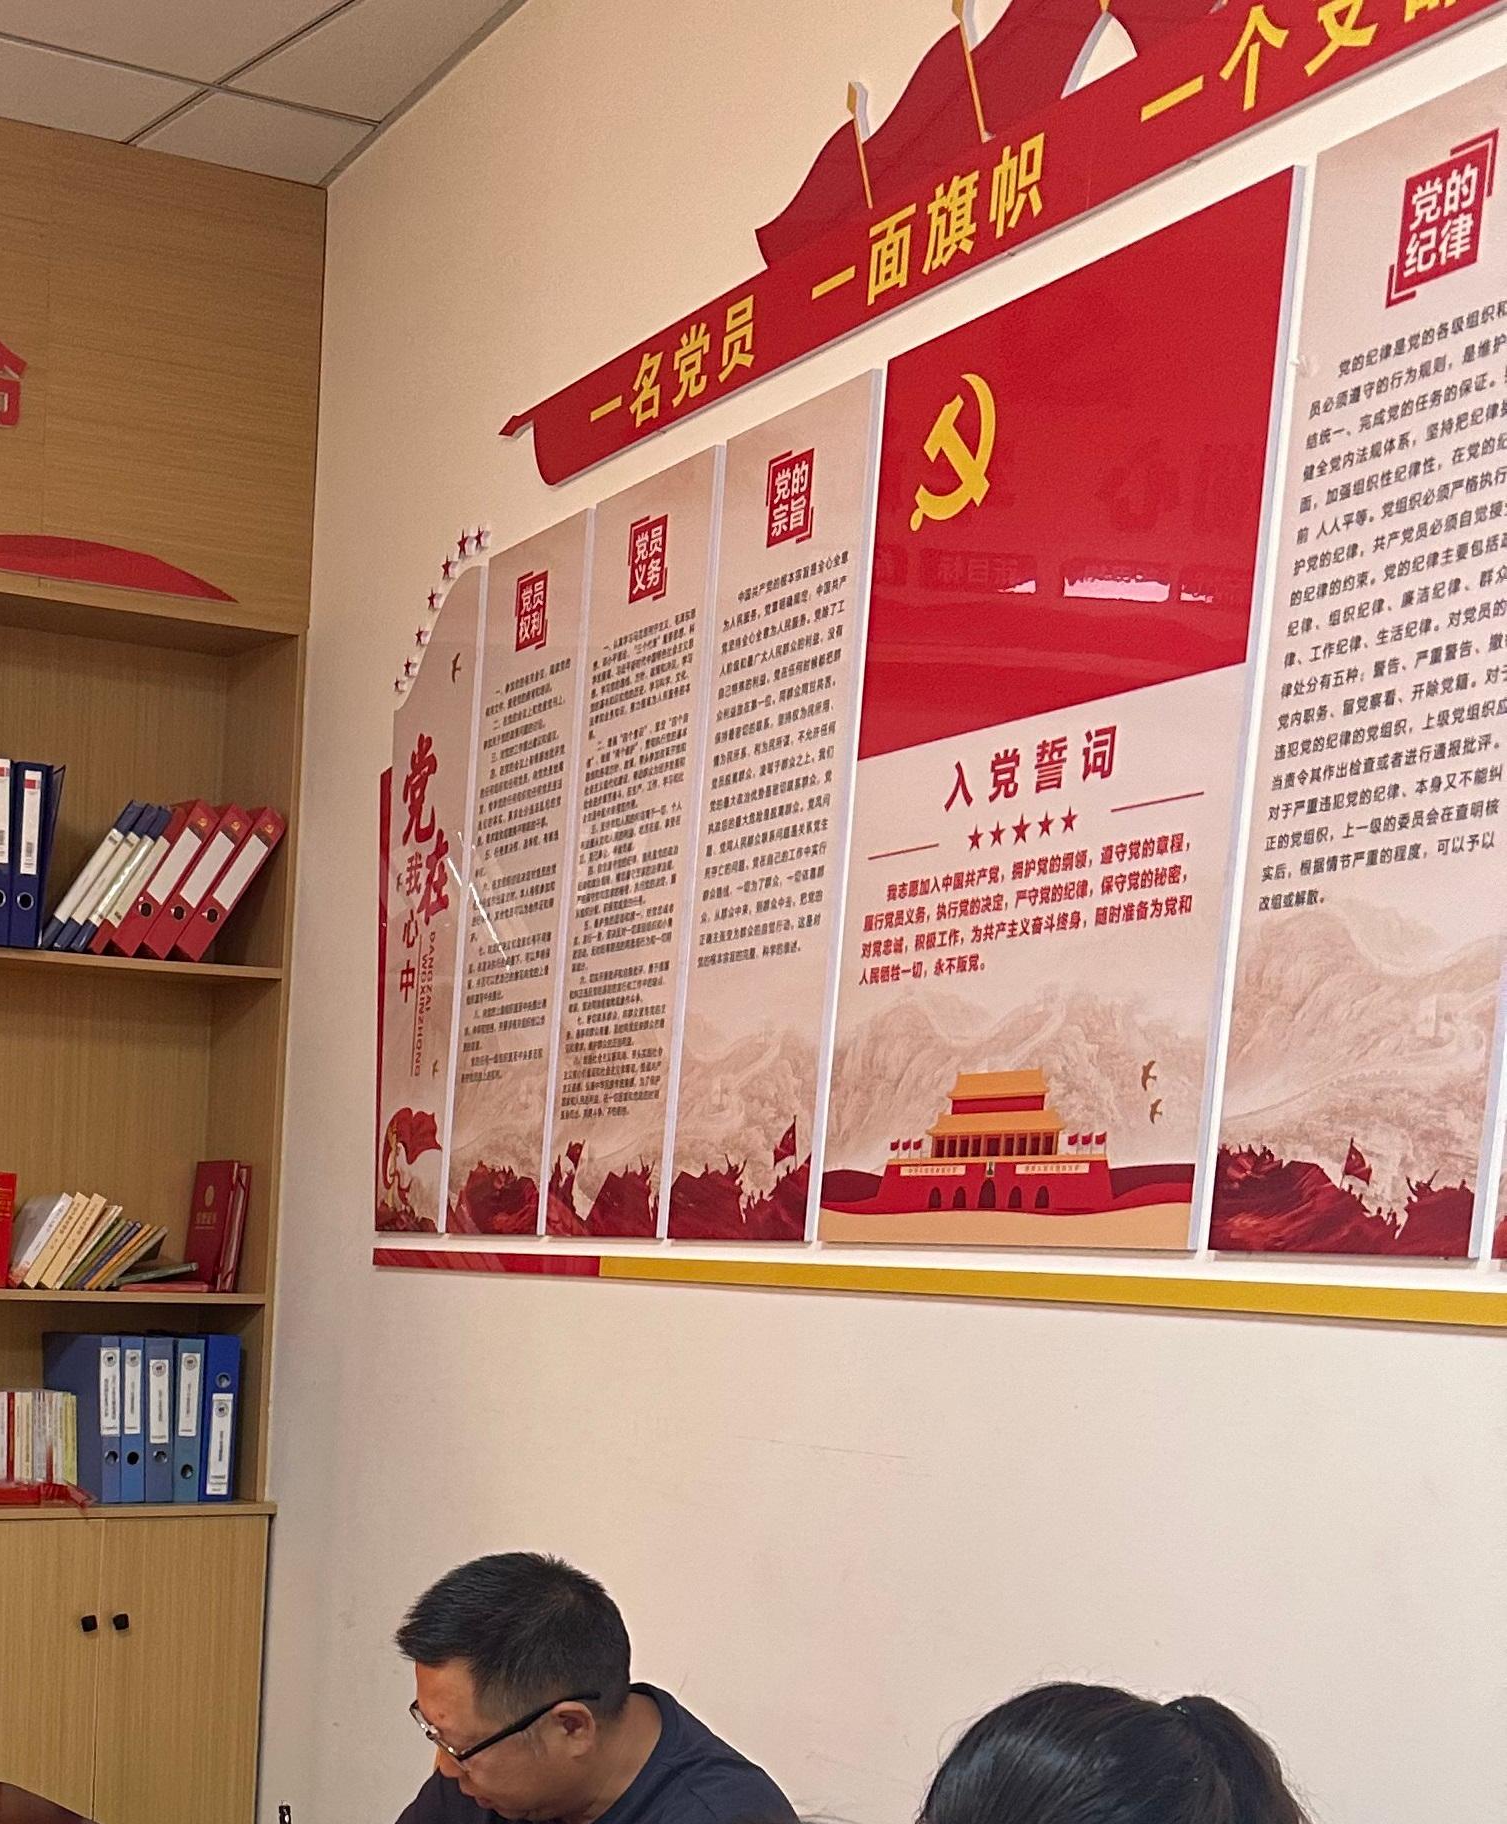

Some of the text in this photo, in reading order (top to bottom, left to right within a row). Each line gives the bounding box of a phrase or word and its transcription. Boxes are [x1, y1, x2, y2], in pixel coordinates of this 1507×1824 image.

[590, 0, 1458, 428] 一名党员 一面旗帜 一个支
[1408, 163, 1478, 231] 党的
[1403, 212, 1474, 278] 纪律
[773, 461, 810, 505] 党的
[771, 494, 806, 538] 宗旨
[634, 528, 663, 564] 党员
[520, 580, 545, 616] 党员
[632, 560, 661, 595] 义务
[519, 611, 543, 644] 权利
[944, 725, 1118, 813] 入党誓词
